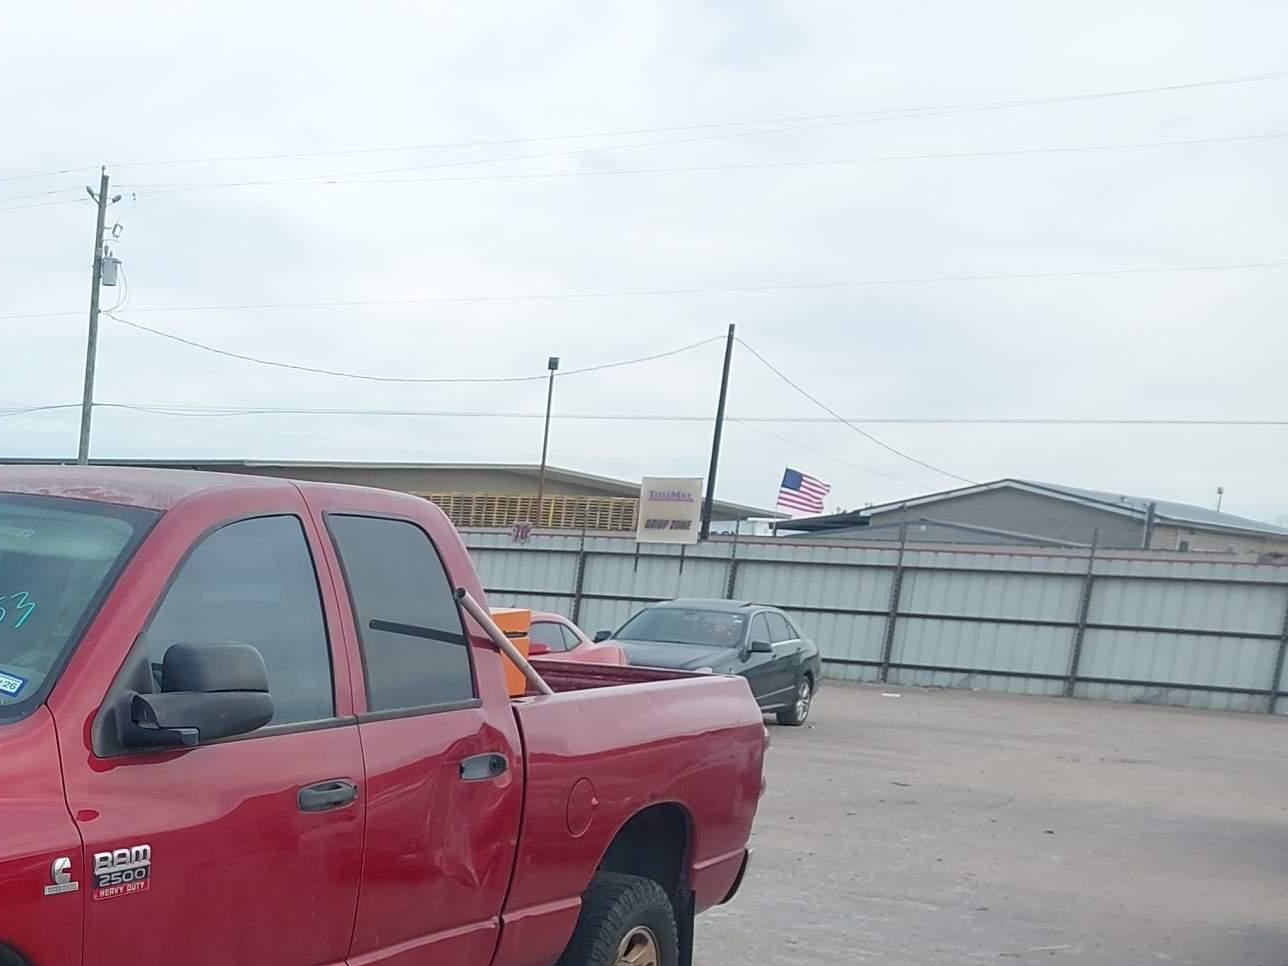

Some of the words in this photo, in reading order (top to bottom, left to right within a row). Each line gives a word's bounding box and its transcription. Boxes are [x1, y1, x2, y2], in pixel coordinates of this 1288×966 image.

[93, 844, 151, 875] RAM
[99, 868, 146, 888] 2500
[99, 887, 124, 898] HEAVY
[126, 881, 145, 892] DUTY
